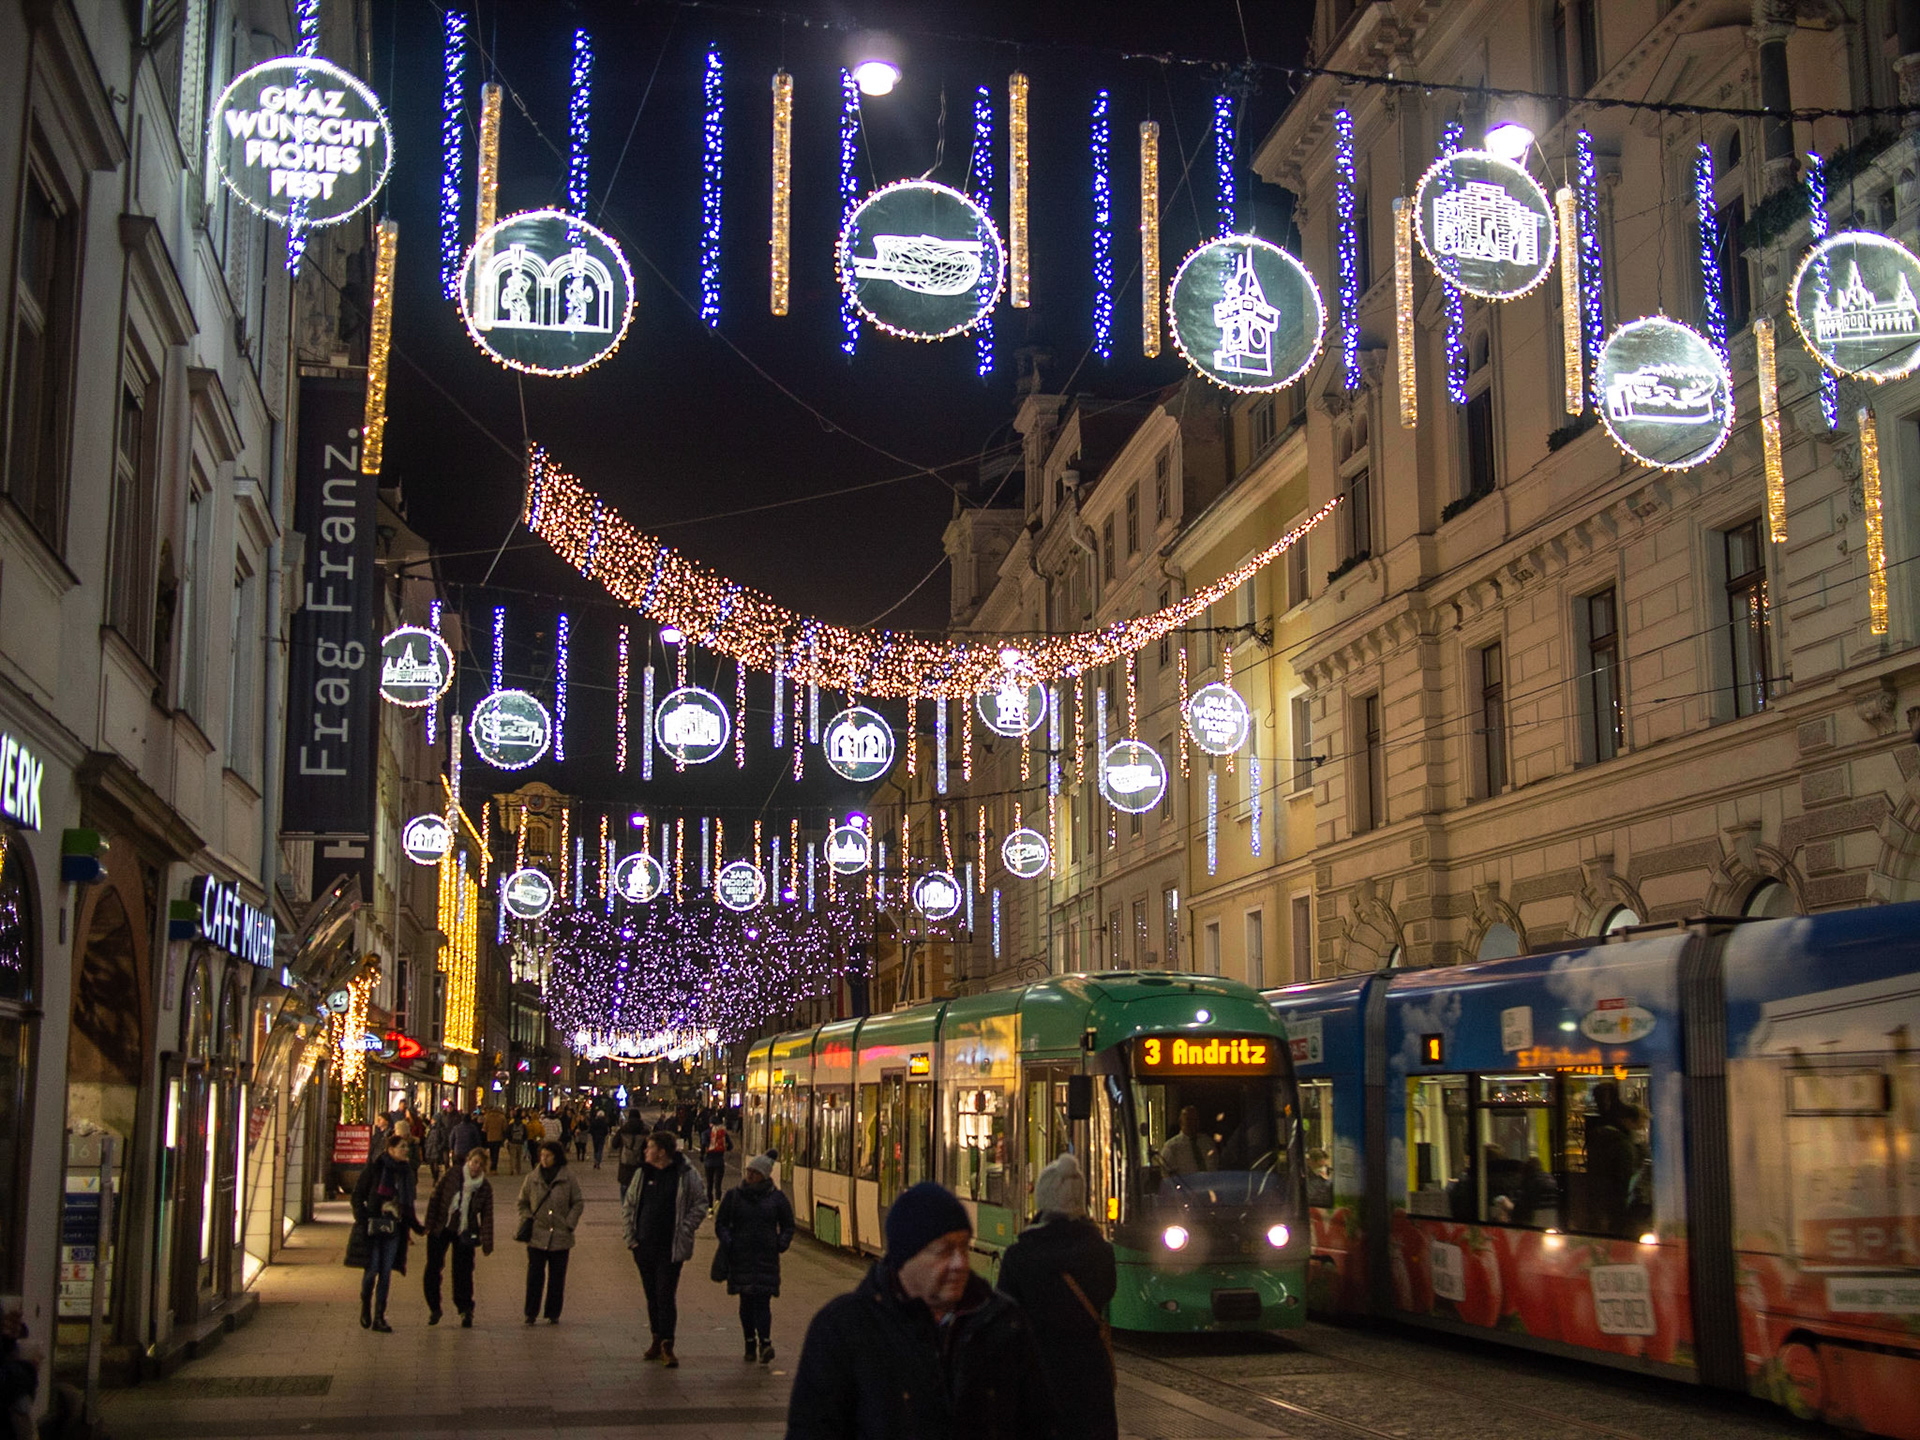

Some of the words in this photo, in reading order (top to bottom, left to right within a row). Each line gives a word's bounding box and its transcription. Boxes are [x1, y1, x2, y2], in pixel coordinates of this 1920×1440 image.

[260, 85, 346, 118] GRAZ
[225, 108, 379, 148] WÜNSCHT
[245, 139, 362, 174] FROHES
[270, 169, 338, 200] FEST
[306, 427, 359, 612] Franz.
[300, 636, 365, 776] Frag
[203, 873, 241, 954] CAFÉ
[242, 903, 276, 969] MUHR
[1144, 1038, 1161, 1065] 3
[1172, 1038, 1266, 1065] Andritz
[1429, 1039, 1440, 1060] 1
[1107, 1197, 1119, 1220] 3
